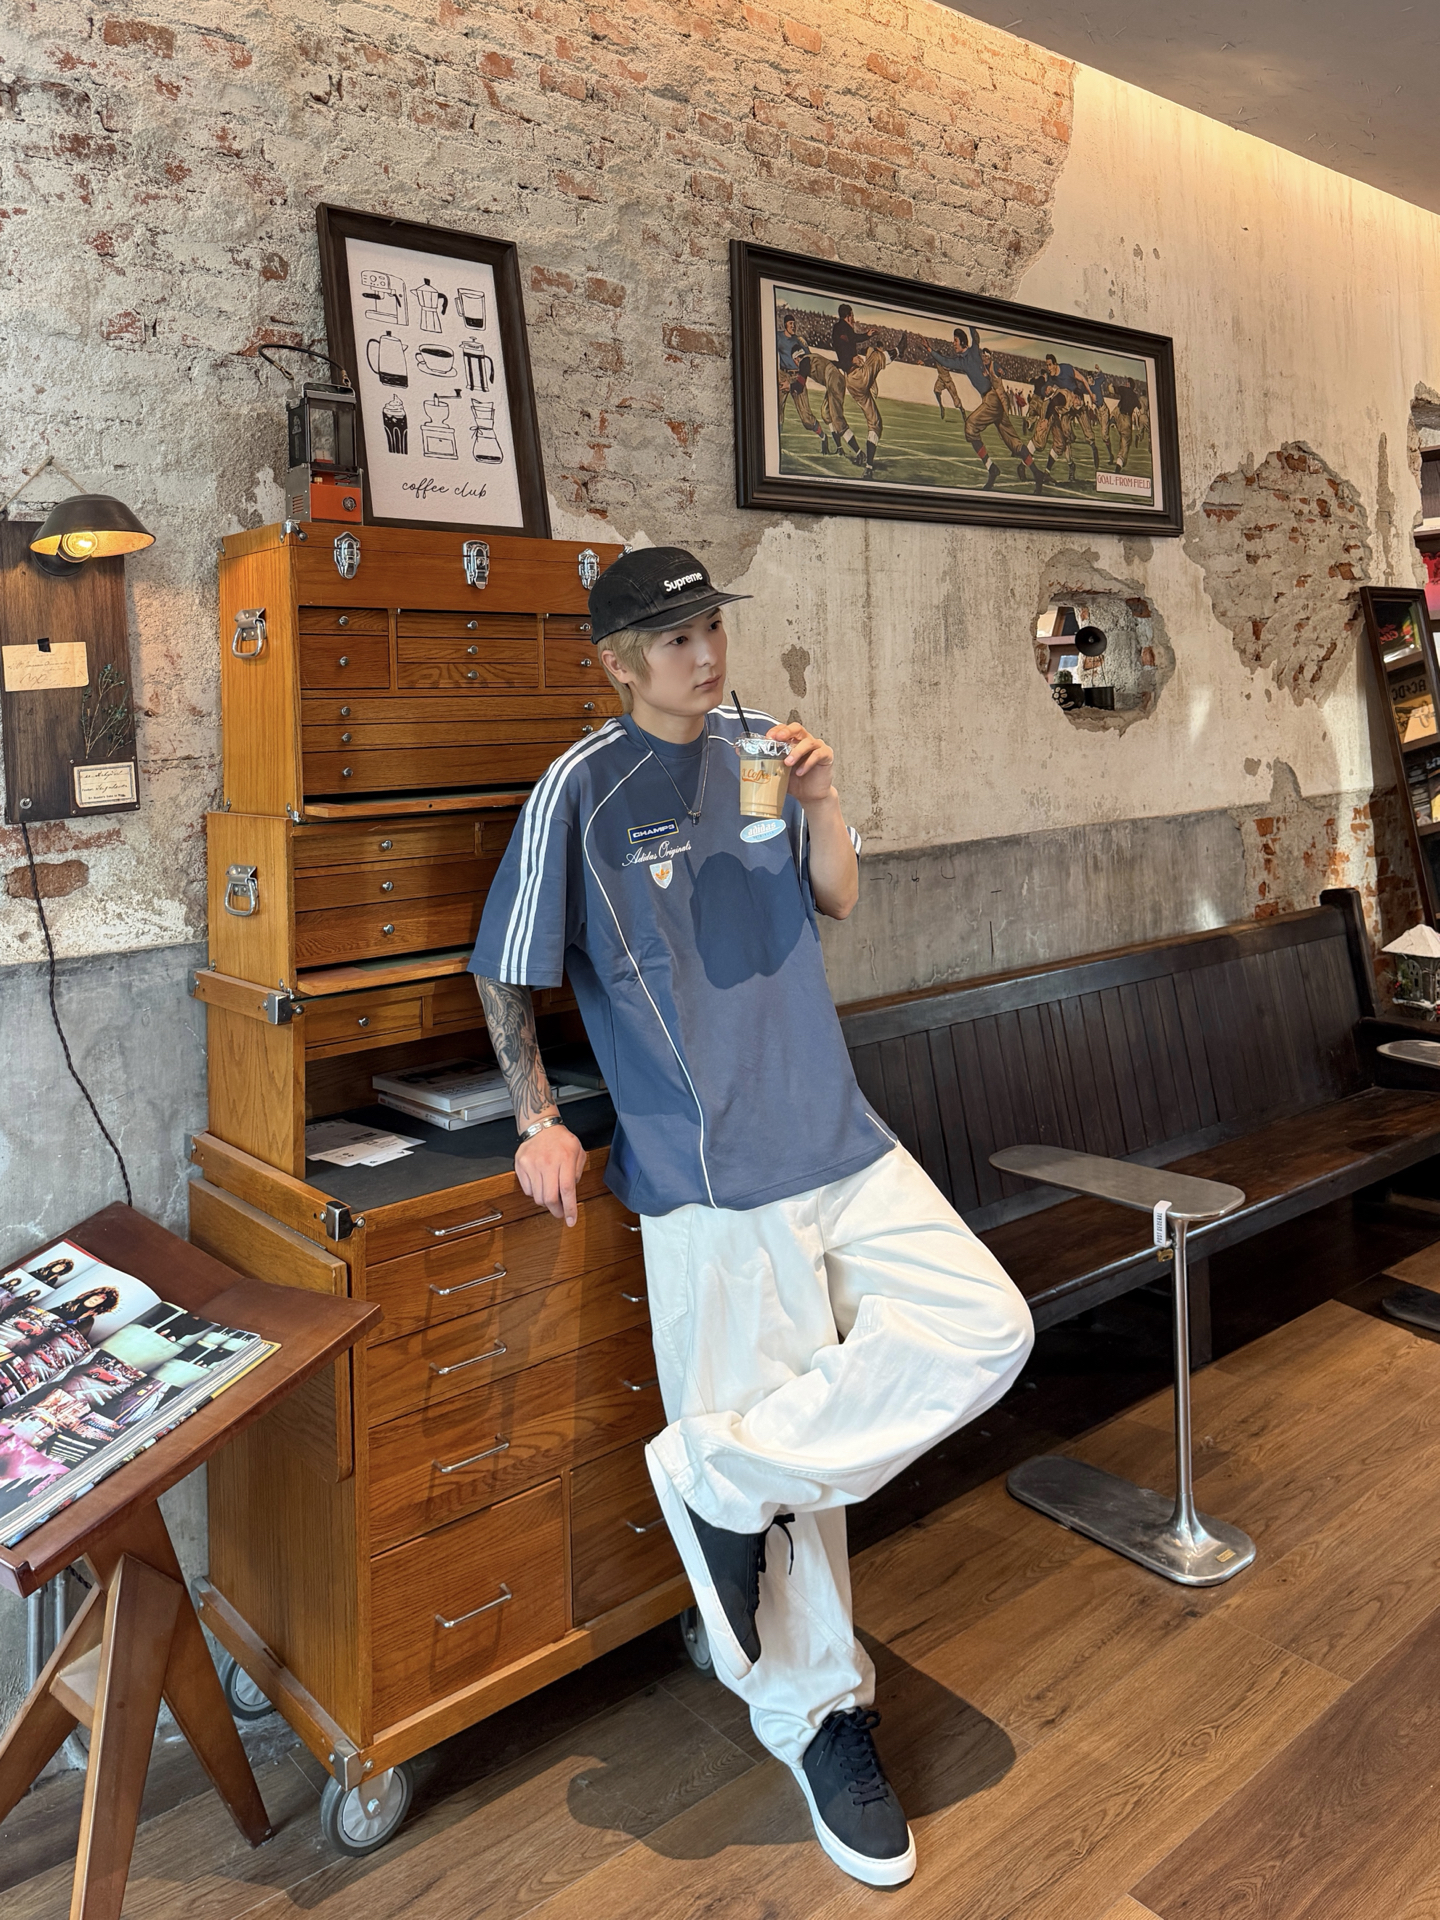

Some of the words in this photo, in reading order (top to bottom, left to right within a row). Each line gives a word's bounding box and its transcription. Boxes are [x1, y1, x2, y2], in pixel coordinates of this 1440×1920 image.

[402, 478, 449, 499] coffee
[454, 482, 487, 498] club
[1133, 478, 1151, 490] FIELD
[663, 572, 703, 592] Supreme
[747, 821, 776, 836] adidas
[621, 846, 658, 867] Adidas
[658, 840, 692, 858] Originals
